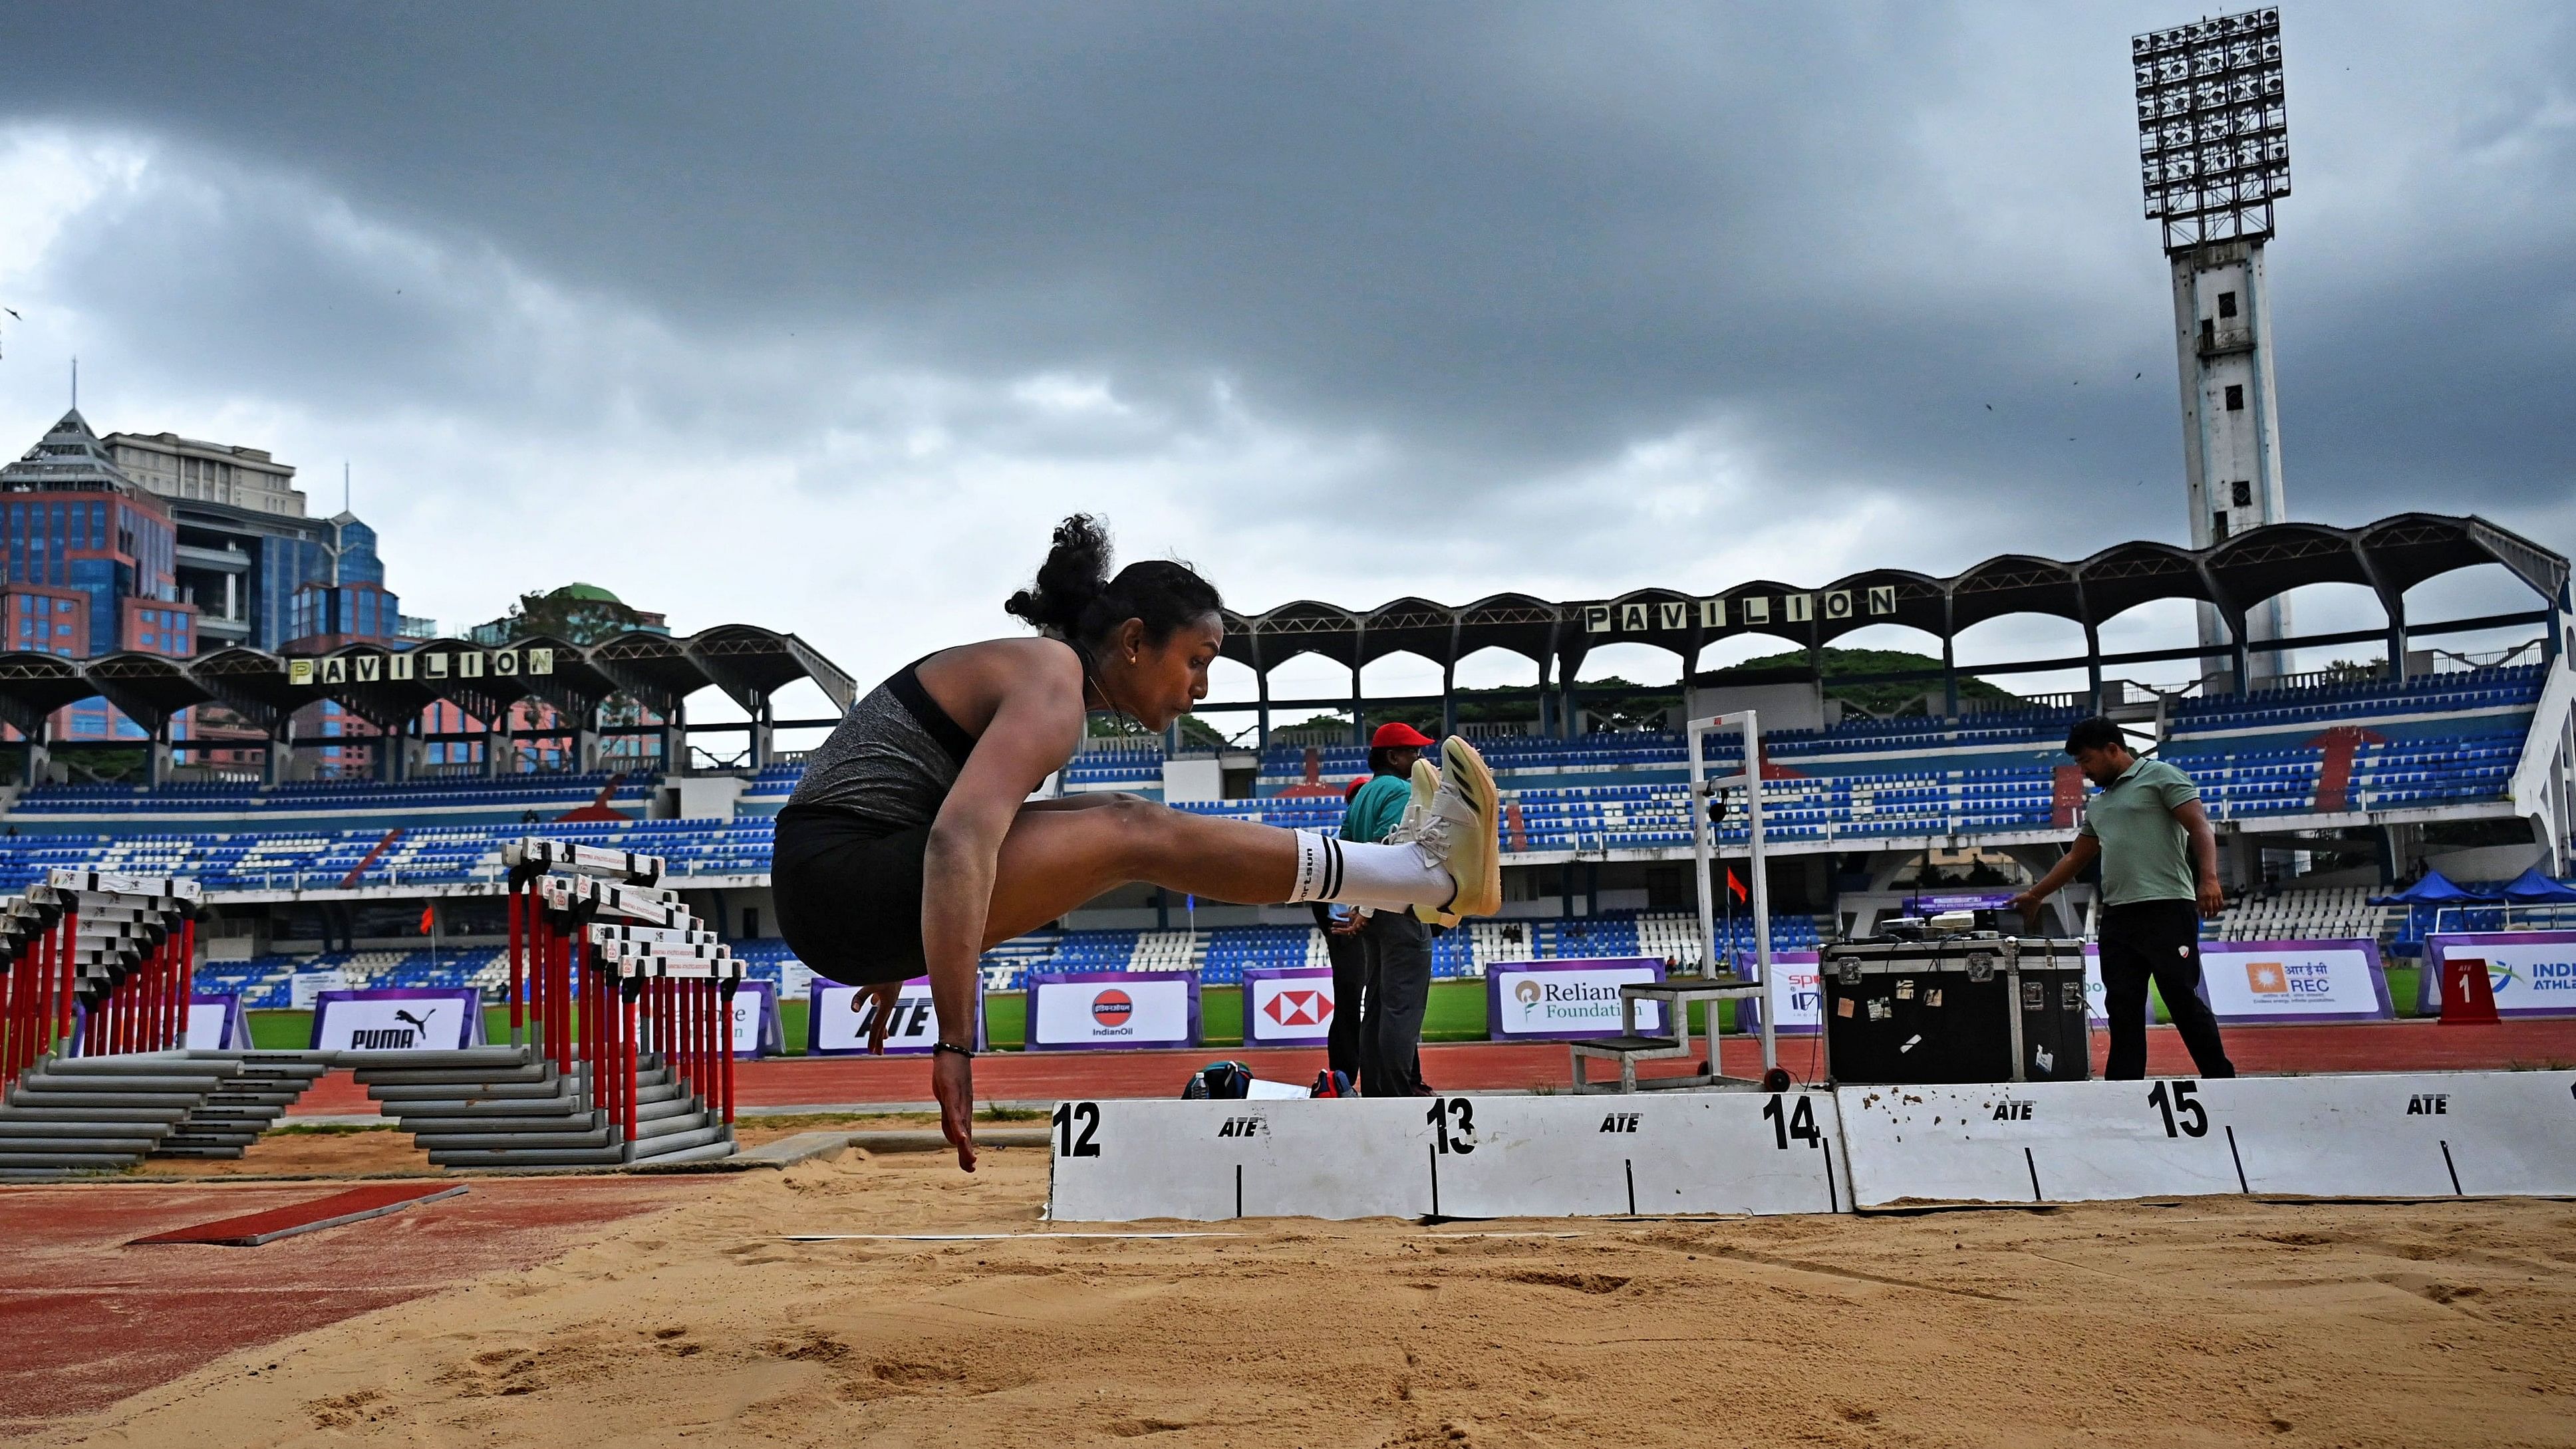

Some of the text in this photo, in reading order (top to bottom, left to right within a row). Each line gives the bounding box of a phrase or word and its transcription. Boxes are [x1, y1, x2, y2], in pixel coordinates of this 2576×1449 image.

[1588, 589, 1894, 630] PAVILION
[291, 651, 550, 683] PAVILION
[1544, 982, 1622, 1002] Relian
[2291, 979, 2330, 992] REC
[2459, 974, 2470, 1003] 1
[1546, 1003, 1642, 1018] Foundatin
[351, 1029, 416, 1049] PUMA
[1993, 1101, 2033, 1120] ATE
[2148, 1080, 2208, 1138] 15
[2406, 1094, 2447, 1115] ATE
[1053, 1102, 1100, 1158] 12
[1218, 1117, 1260, 1138] ATE
[1427, 1098, 1475, 1154] 13
[1599, 1113, 1640, 1132] ATE
[1763, 1094, 1821, 1150] 14
